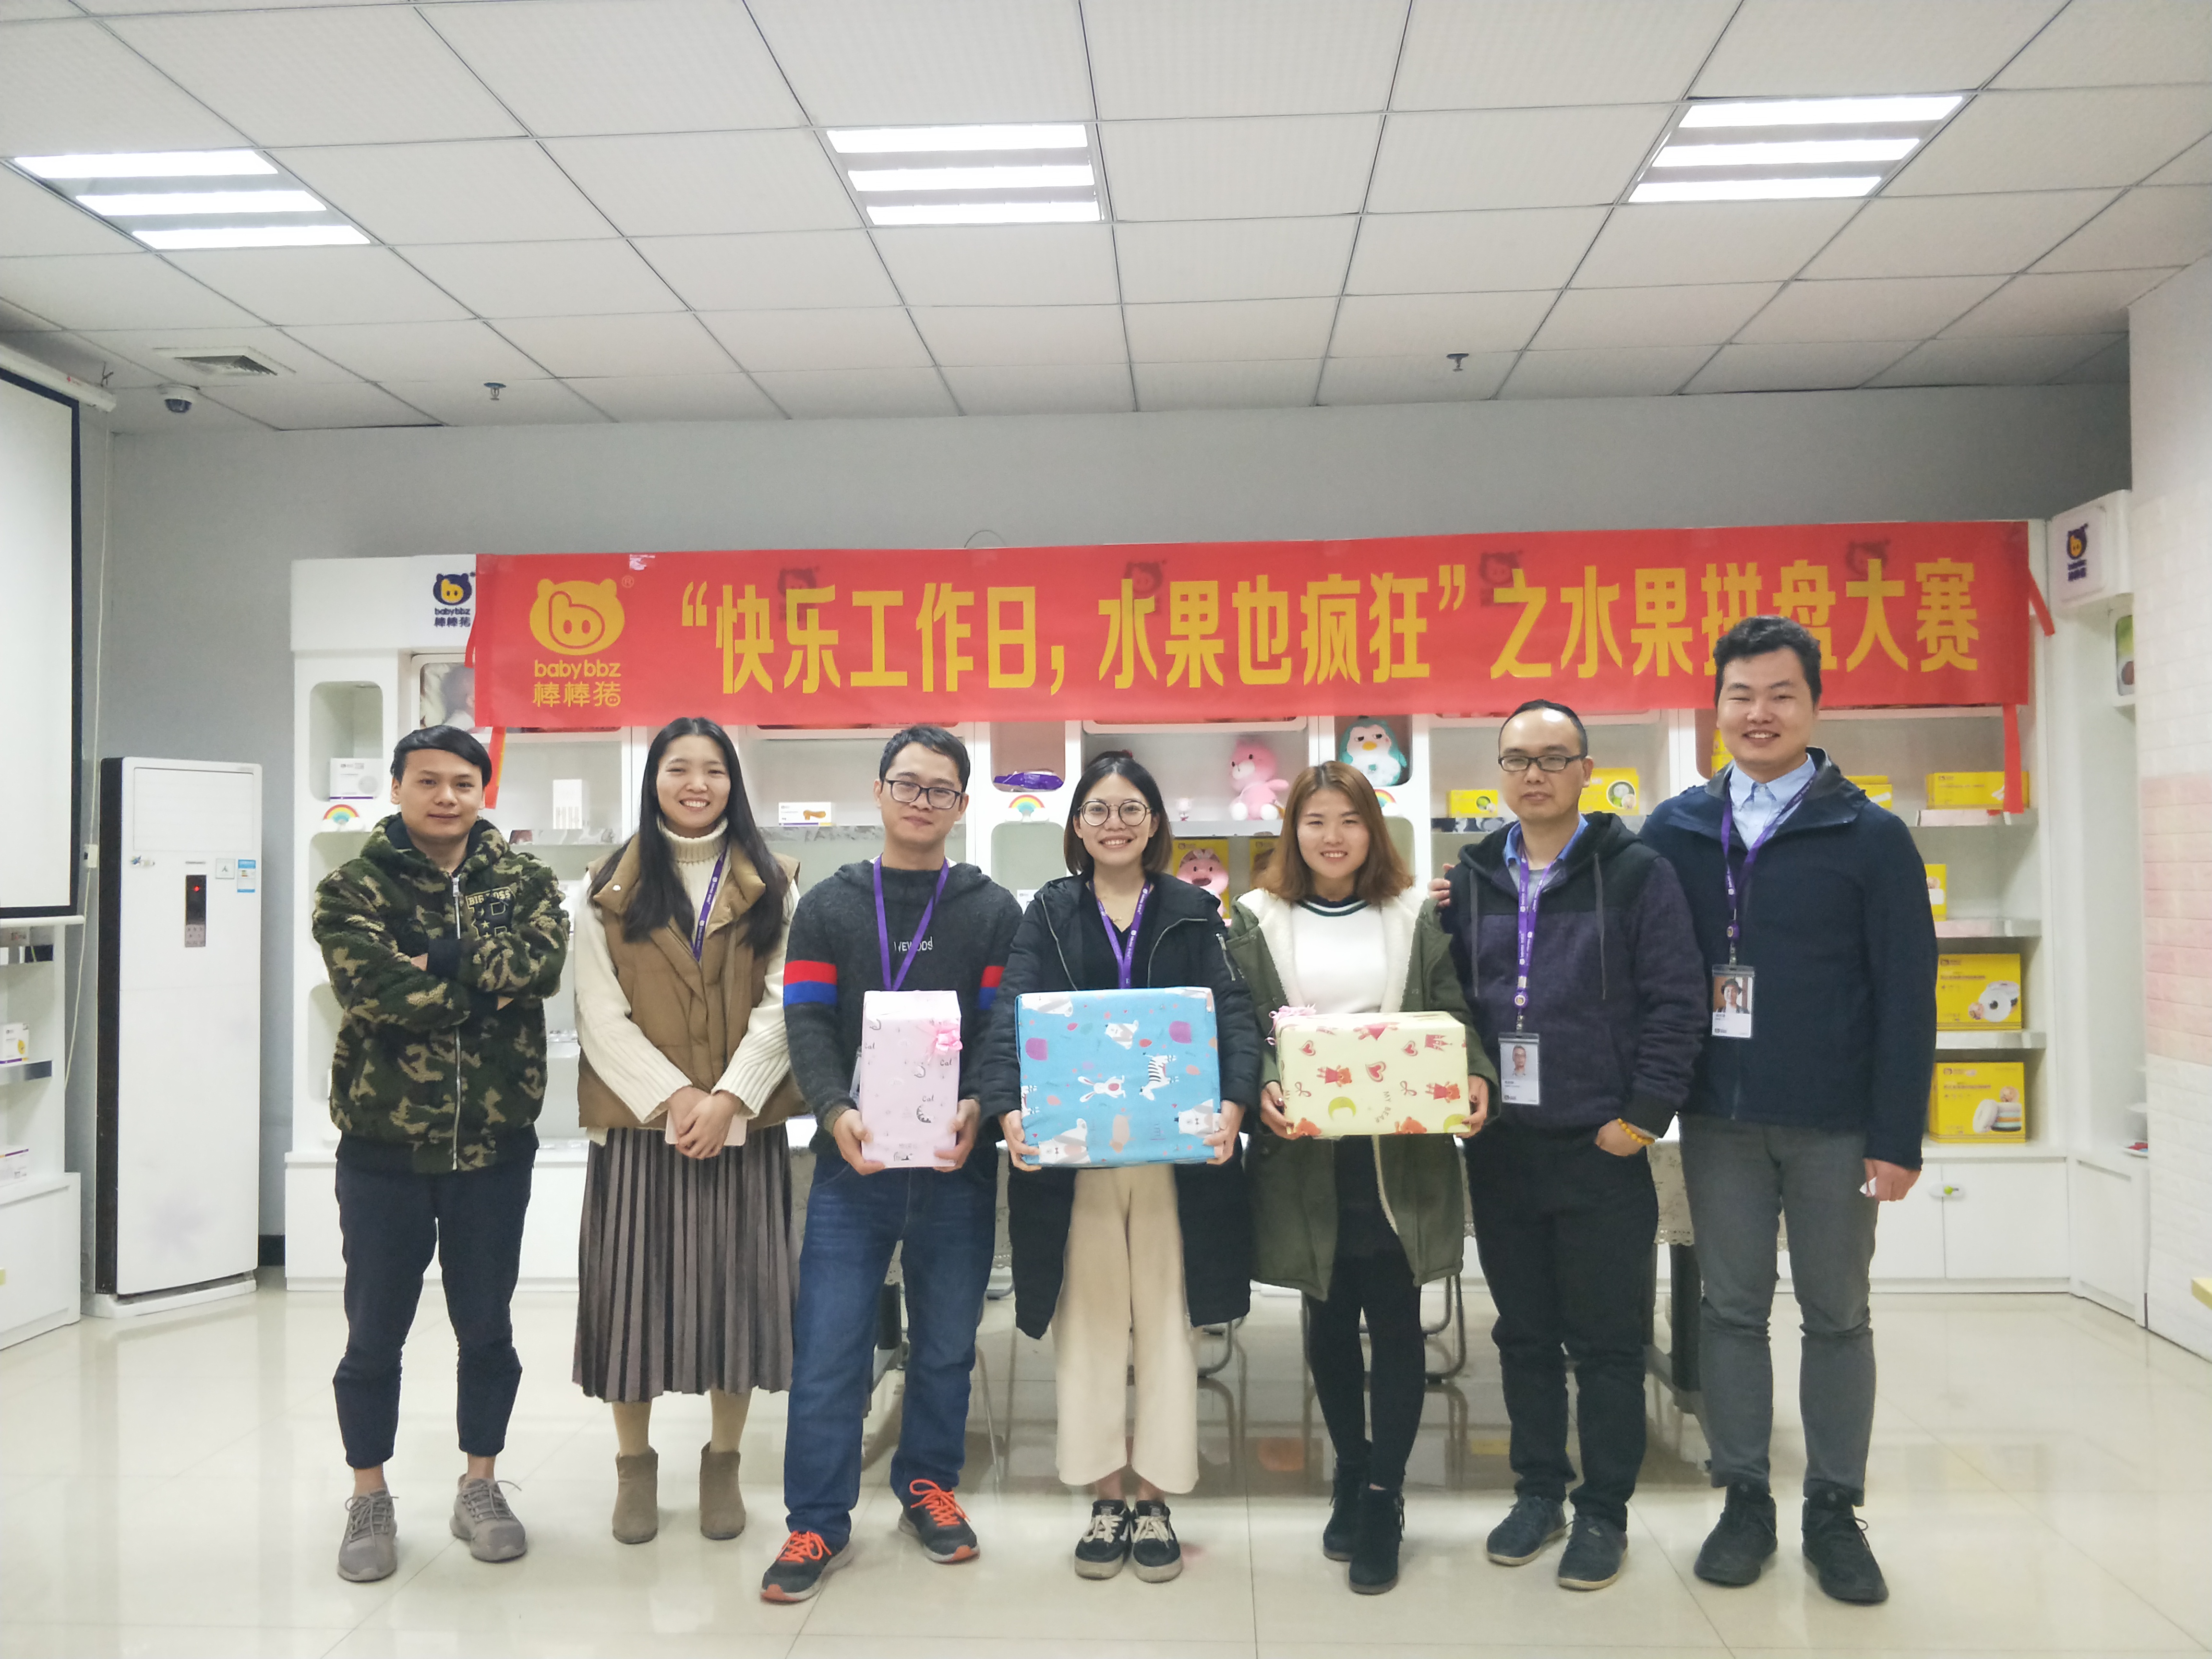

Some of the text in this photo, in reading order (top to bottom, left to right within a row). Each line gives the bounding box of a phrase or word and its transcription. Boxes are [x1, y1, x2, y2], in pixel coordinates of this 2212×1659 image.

[532, 681, 621, 708] 棒棒猪
[468, 895, 484, 906] BIG
[1382, 1091, 1392, 1102] MY
